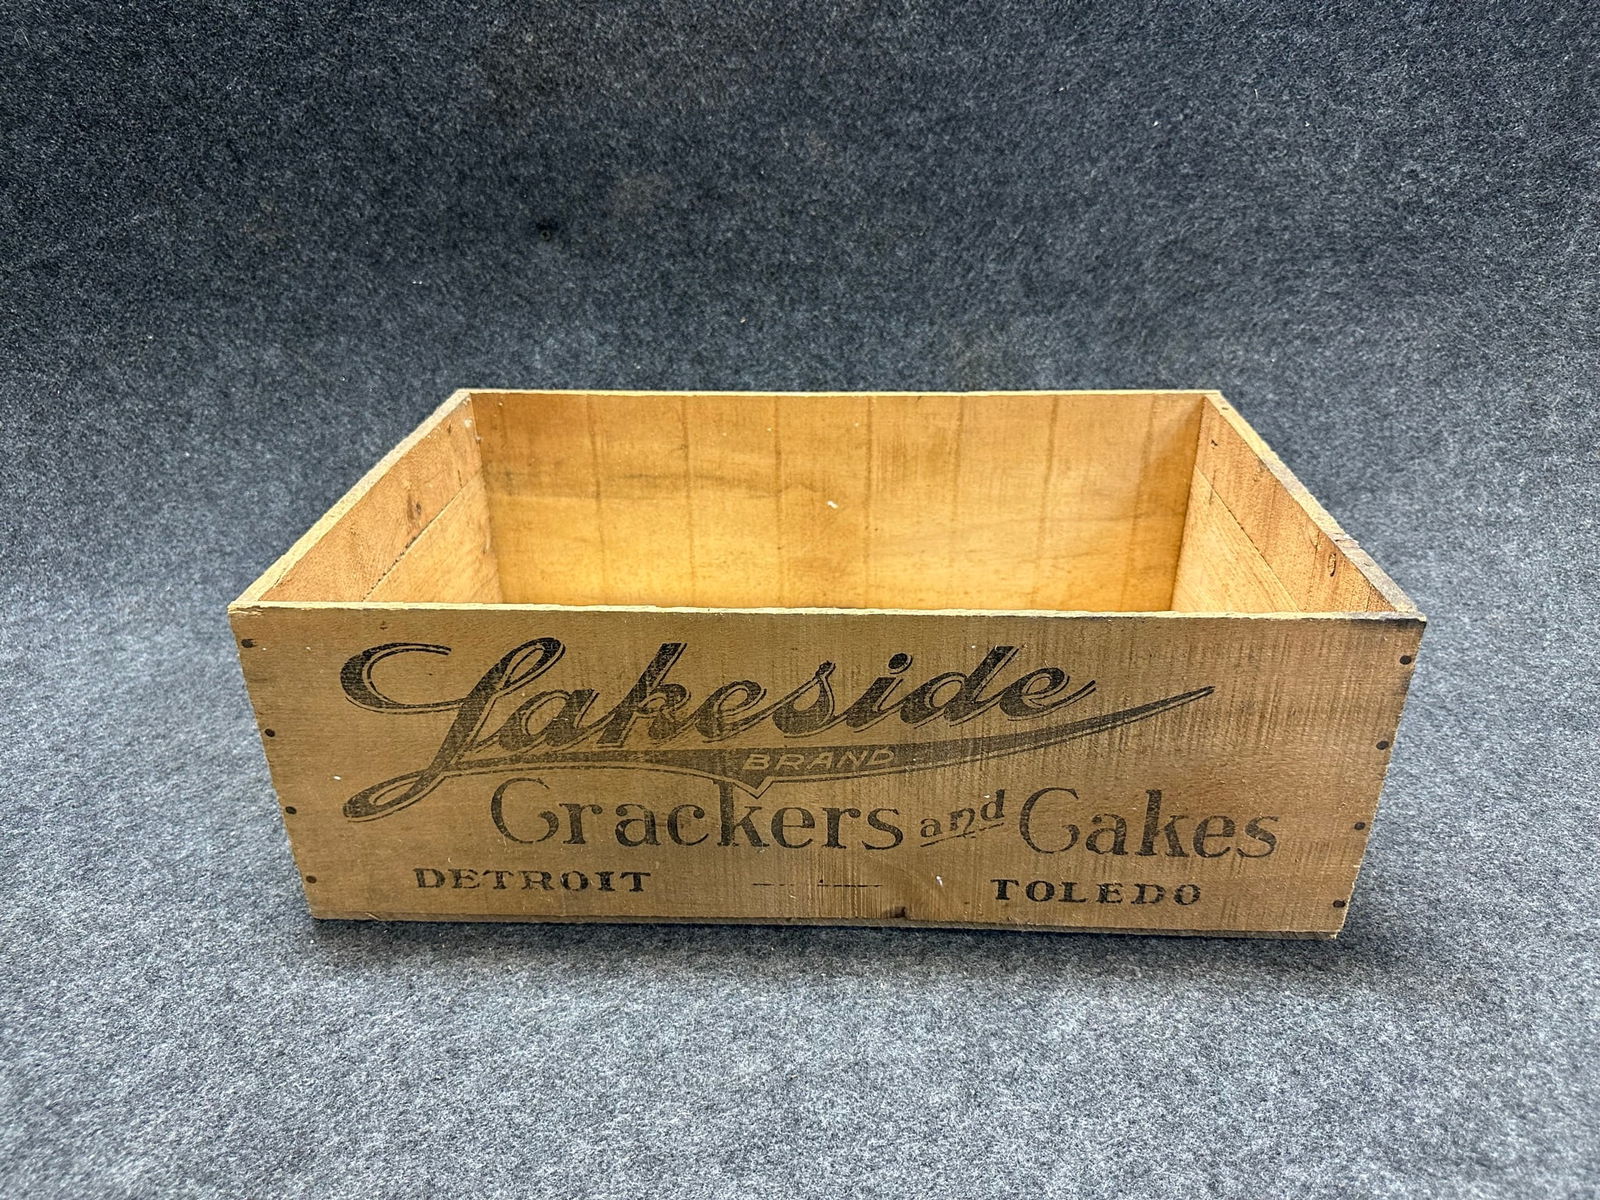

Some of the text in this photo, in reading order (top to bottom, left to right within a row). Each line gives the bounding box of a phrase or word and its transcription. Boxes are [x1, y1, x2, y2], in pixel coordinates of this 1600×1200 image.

[340, 637, 1096, 822] Lakeside
[744, 748, 895, 771] BRAND
[491, 777, 1279, 860] Crackers and Cakes
[413, 867, 1201, 906] DETROIT TOLEDO
